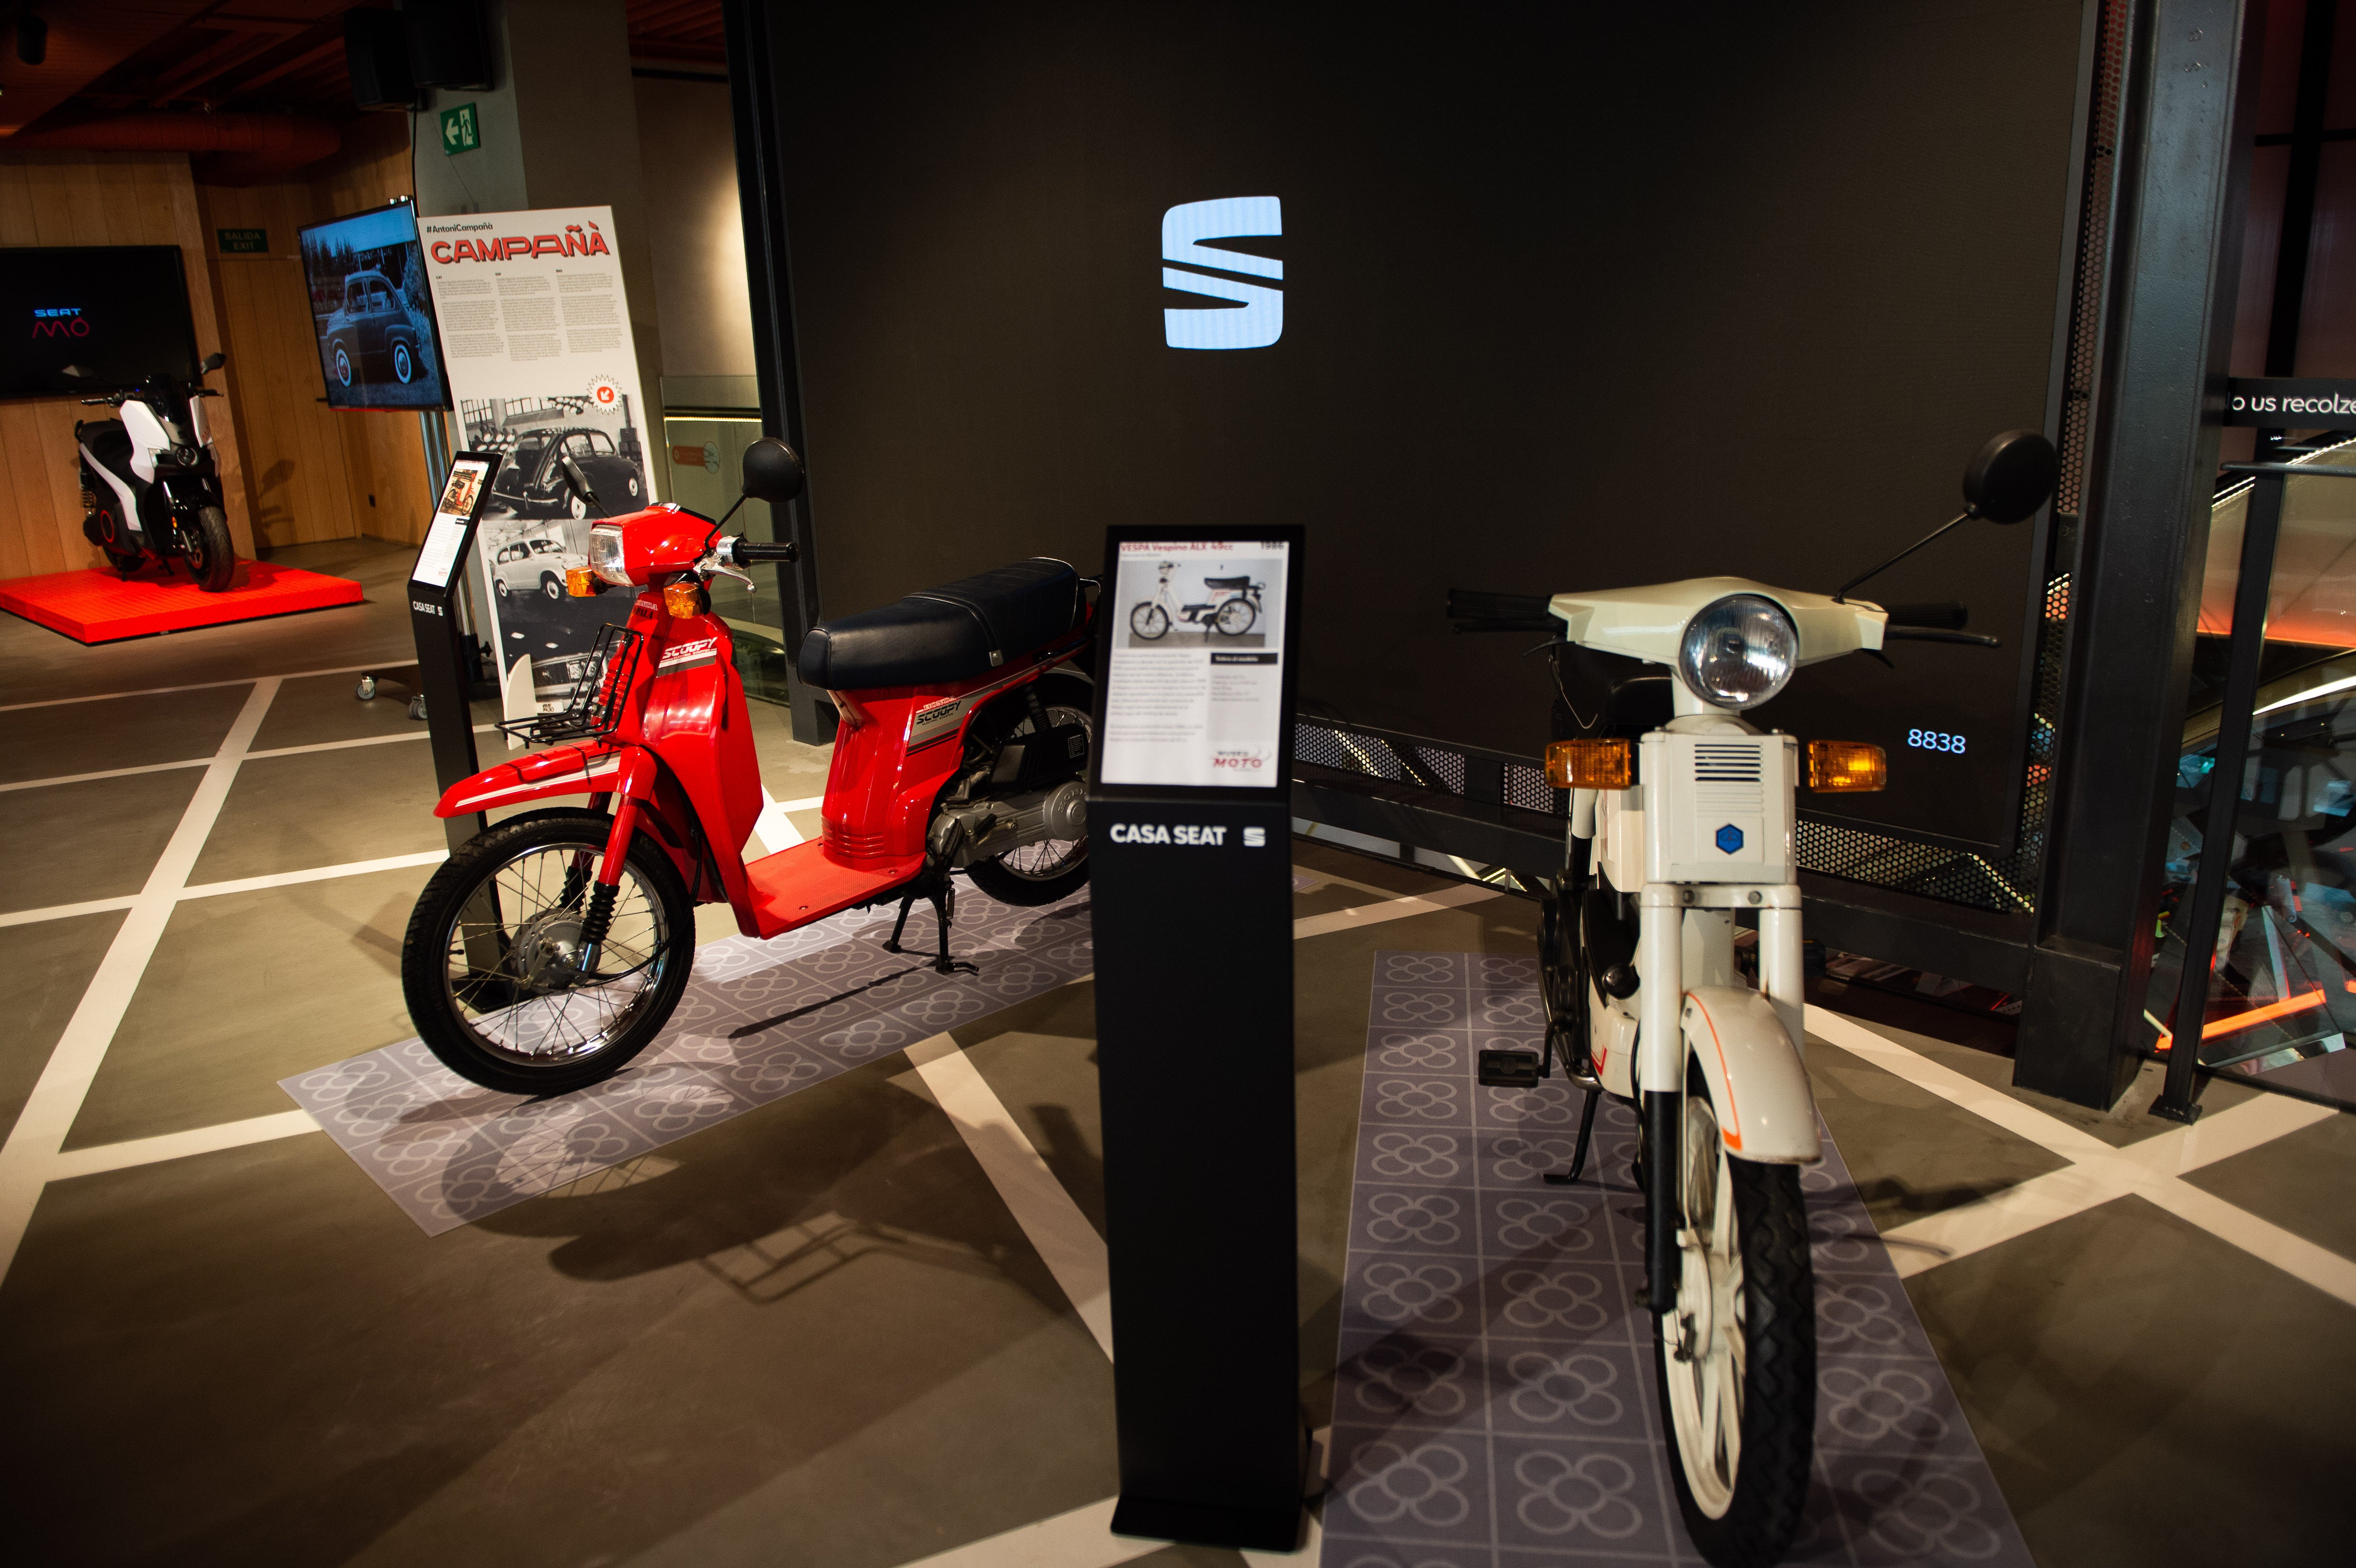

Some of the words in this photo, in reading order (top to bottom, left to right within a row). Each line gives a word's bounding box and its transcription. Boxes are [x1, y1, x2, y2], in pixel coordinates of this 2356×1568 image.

[224, 232, 261, 240] SALIDA
[426, 222, 493, 234] #AntoniCampañà
[233, 241, 254, 250] EXIT
[430, 220, 611, 265] CAMPAÑÀ
[34, 308, 82, 317] SEAT
[2251, 396, 2277, 412] us
[413, 601, 425, 612] CASA
[425, 603, 436, 614] SEAT
[662, 636, 718, 659] SCOOPY
[923, 695, 957, 711] HONDA
[916, 700, 962, 725] SCOOPY
[1907, 728, 1966, 754] 8838
[1213, 758, 1262, 768] MOTO
[1110, 823, 1171, 844] CASA
[1173, 824, 1227, 846] SEAT
